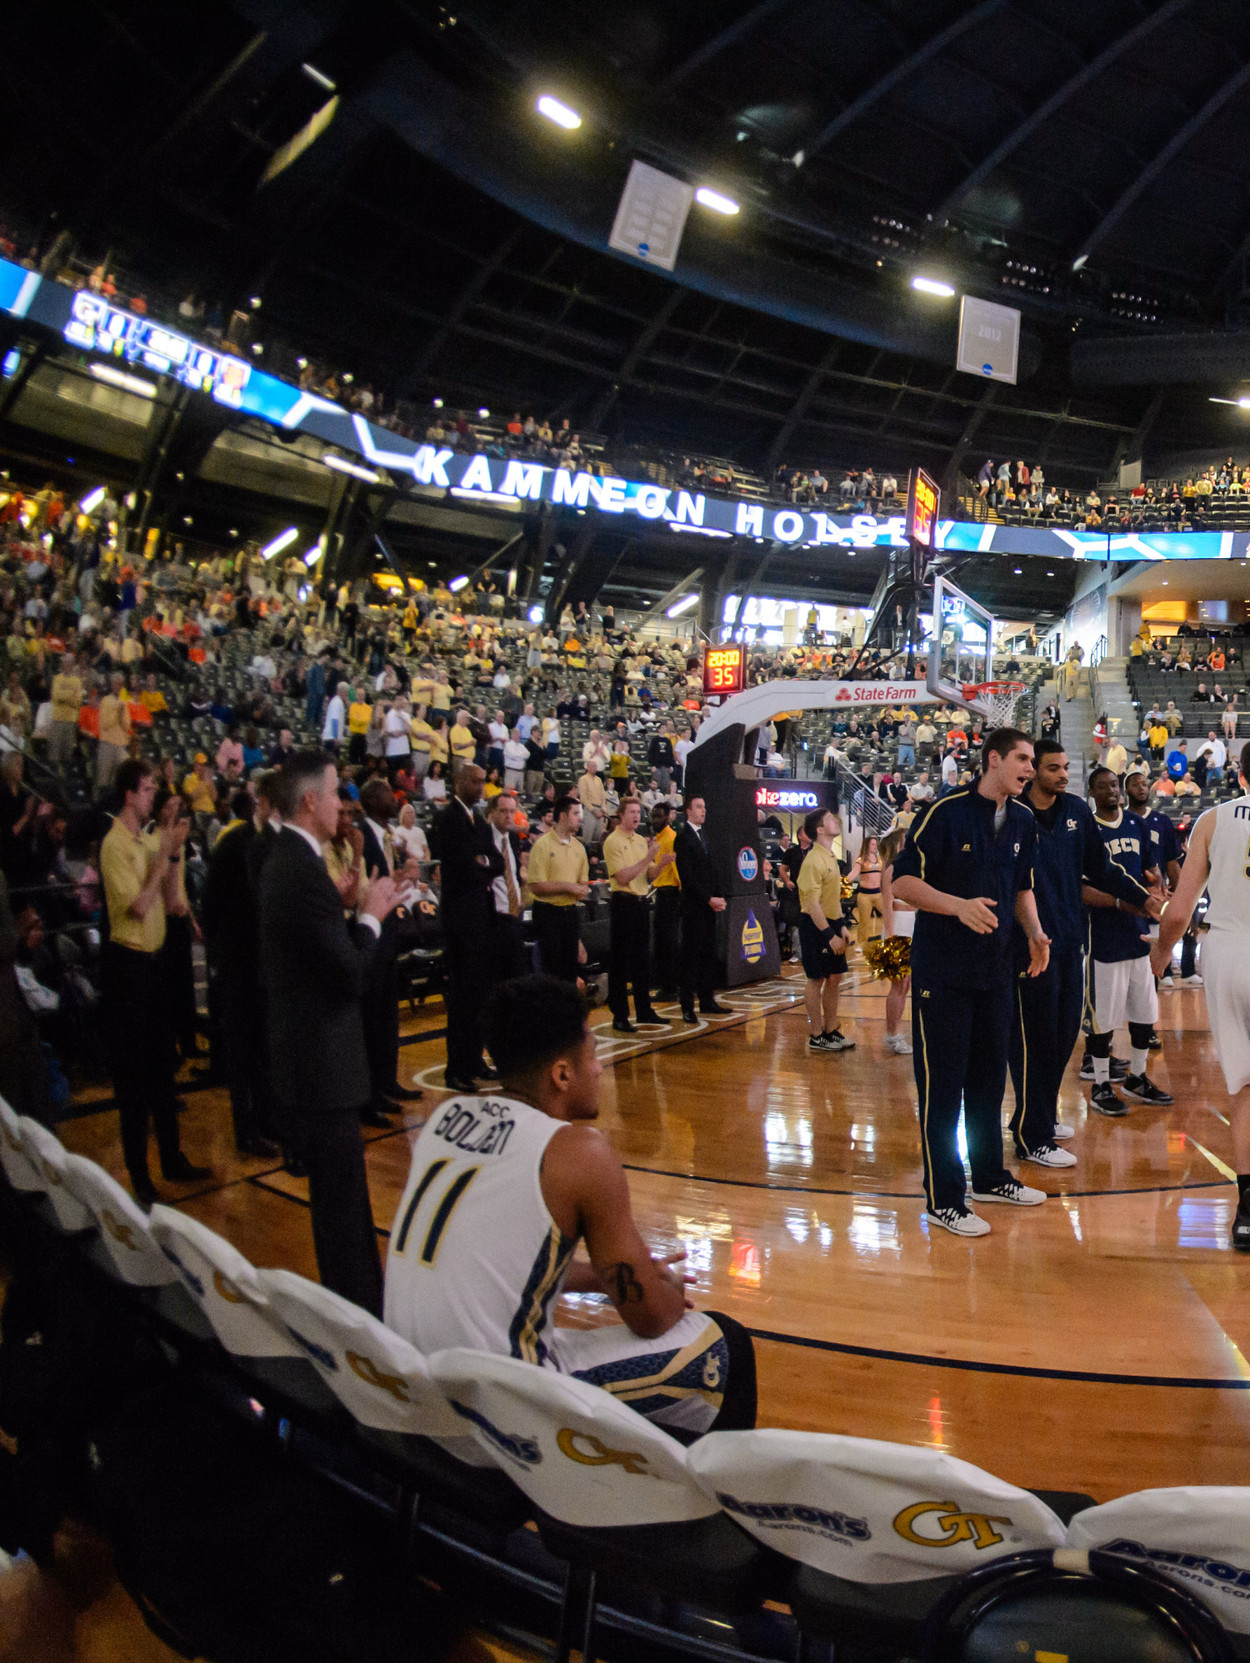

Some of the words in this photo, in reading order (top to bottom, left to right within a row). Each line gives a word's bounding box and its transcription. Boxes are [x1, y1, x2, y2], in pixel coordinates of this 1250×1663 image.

[418, 444, 706, 526] KAMMEON
[734, 501, 955, 549] HOLSEY
[708, 650, 739, 667] 20:00
[714, 667, 734, 686] 35
[481, 1101, 511, 1119] ACC
[393, 1156, 484, 1270] 11
